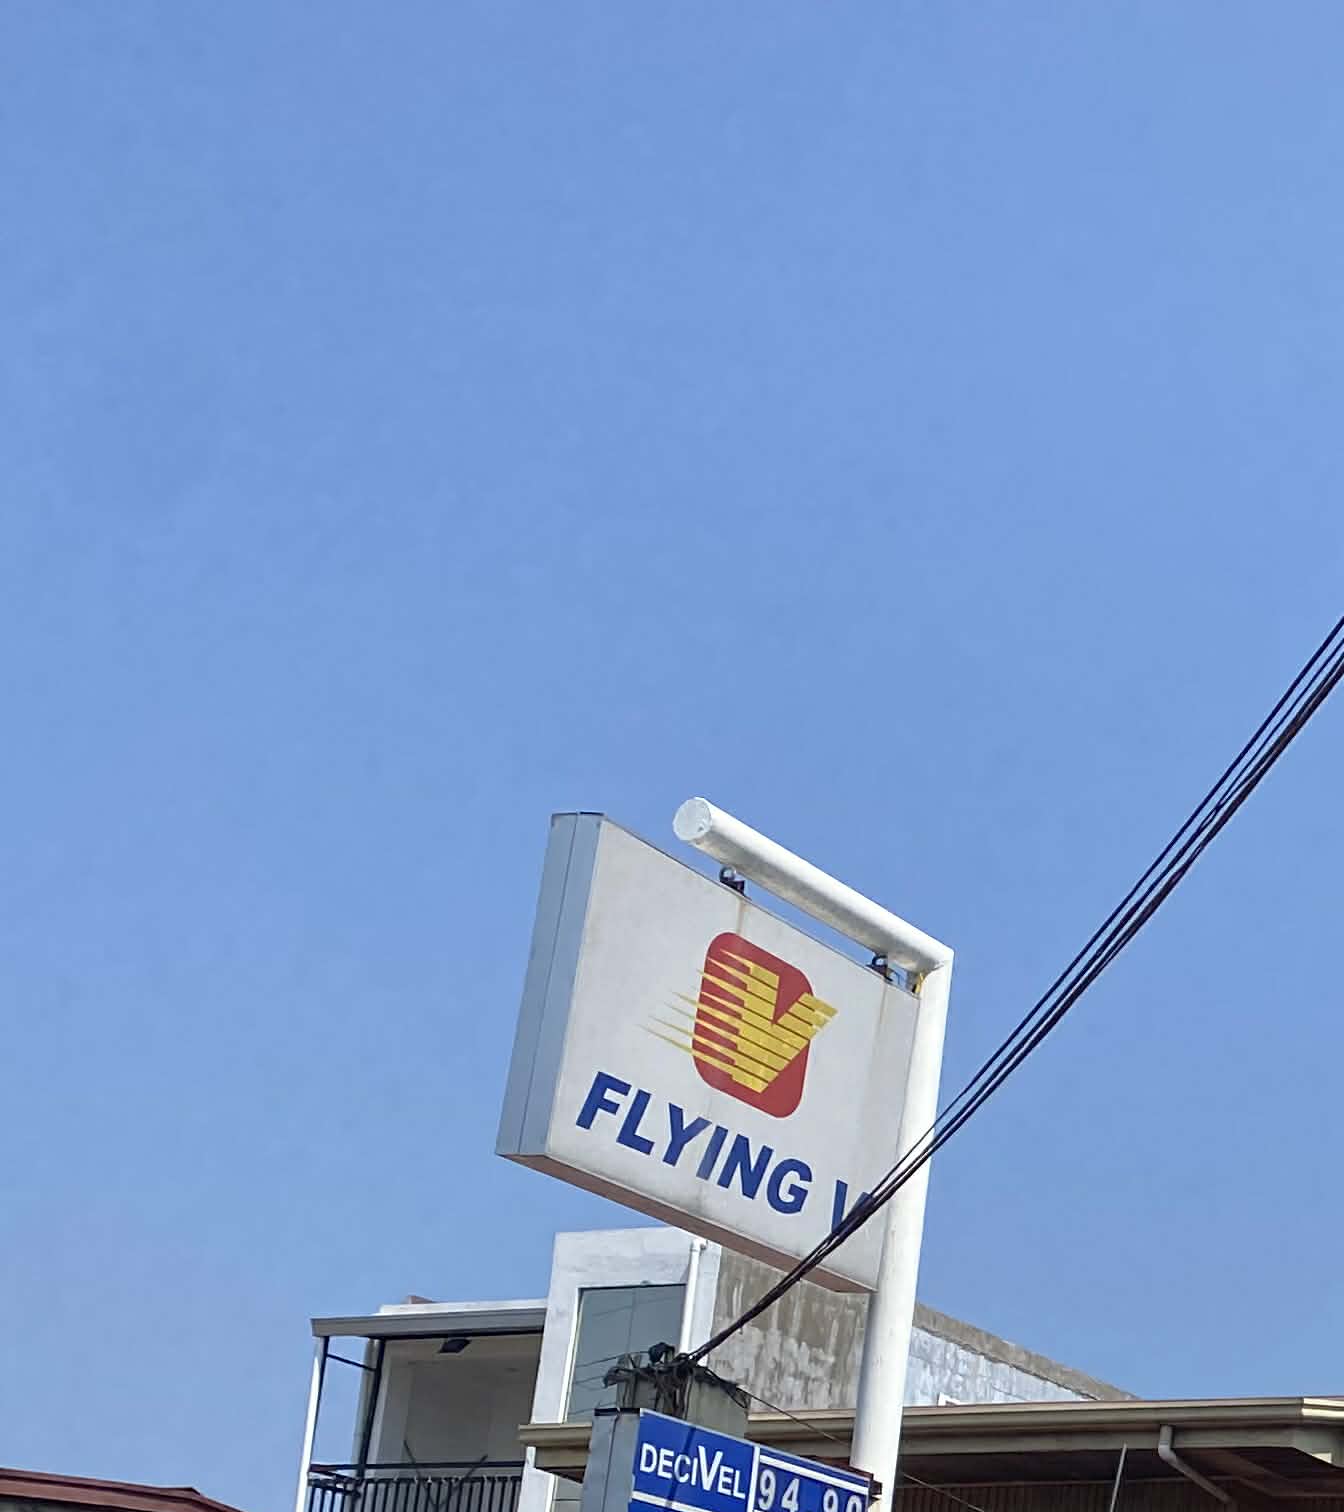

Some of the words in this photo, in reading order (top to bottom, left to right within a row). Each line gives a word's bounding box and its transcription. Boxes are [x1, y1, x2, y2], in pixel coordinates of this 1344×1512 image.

[575, 1071, 813, 1215] FLYING
[831, 1179, 875, 1237] V
[639, 1443, 746, 1499] DECIVEL
